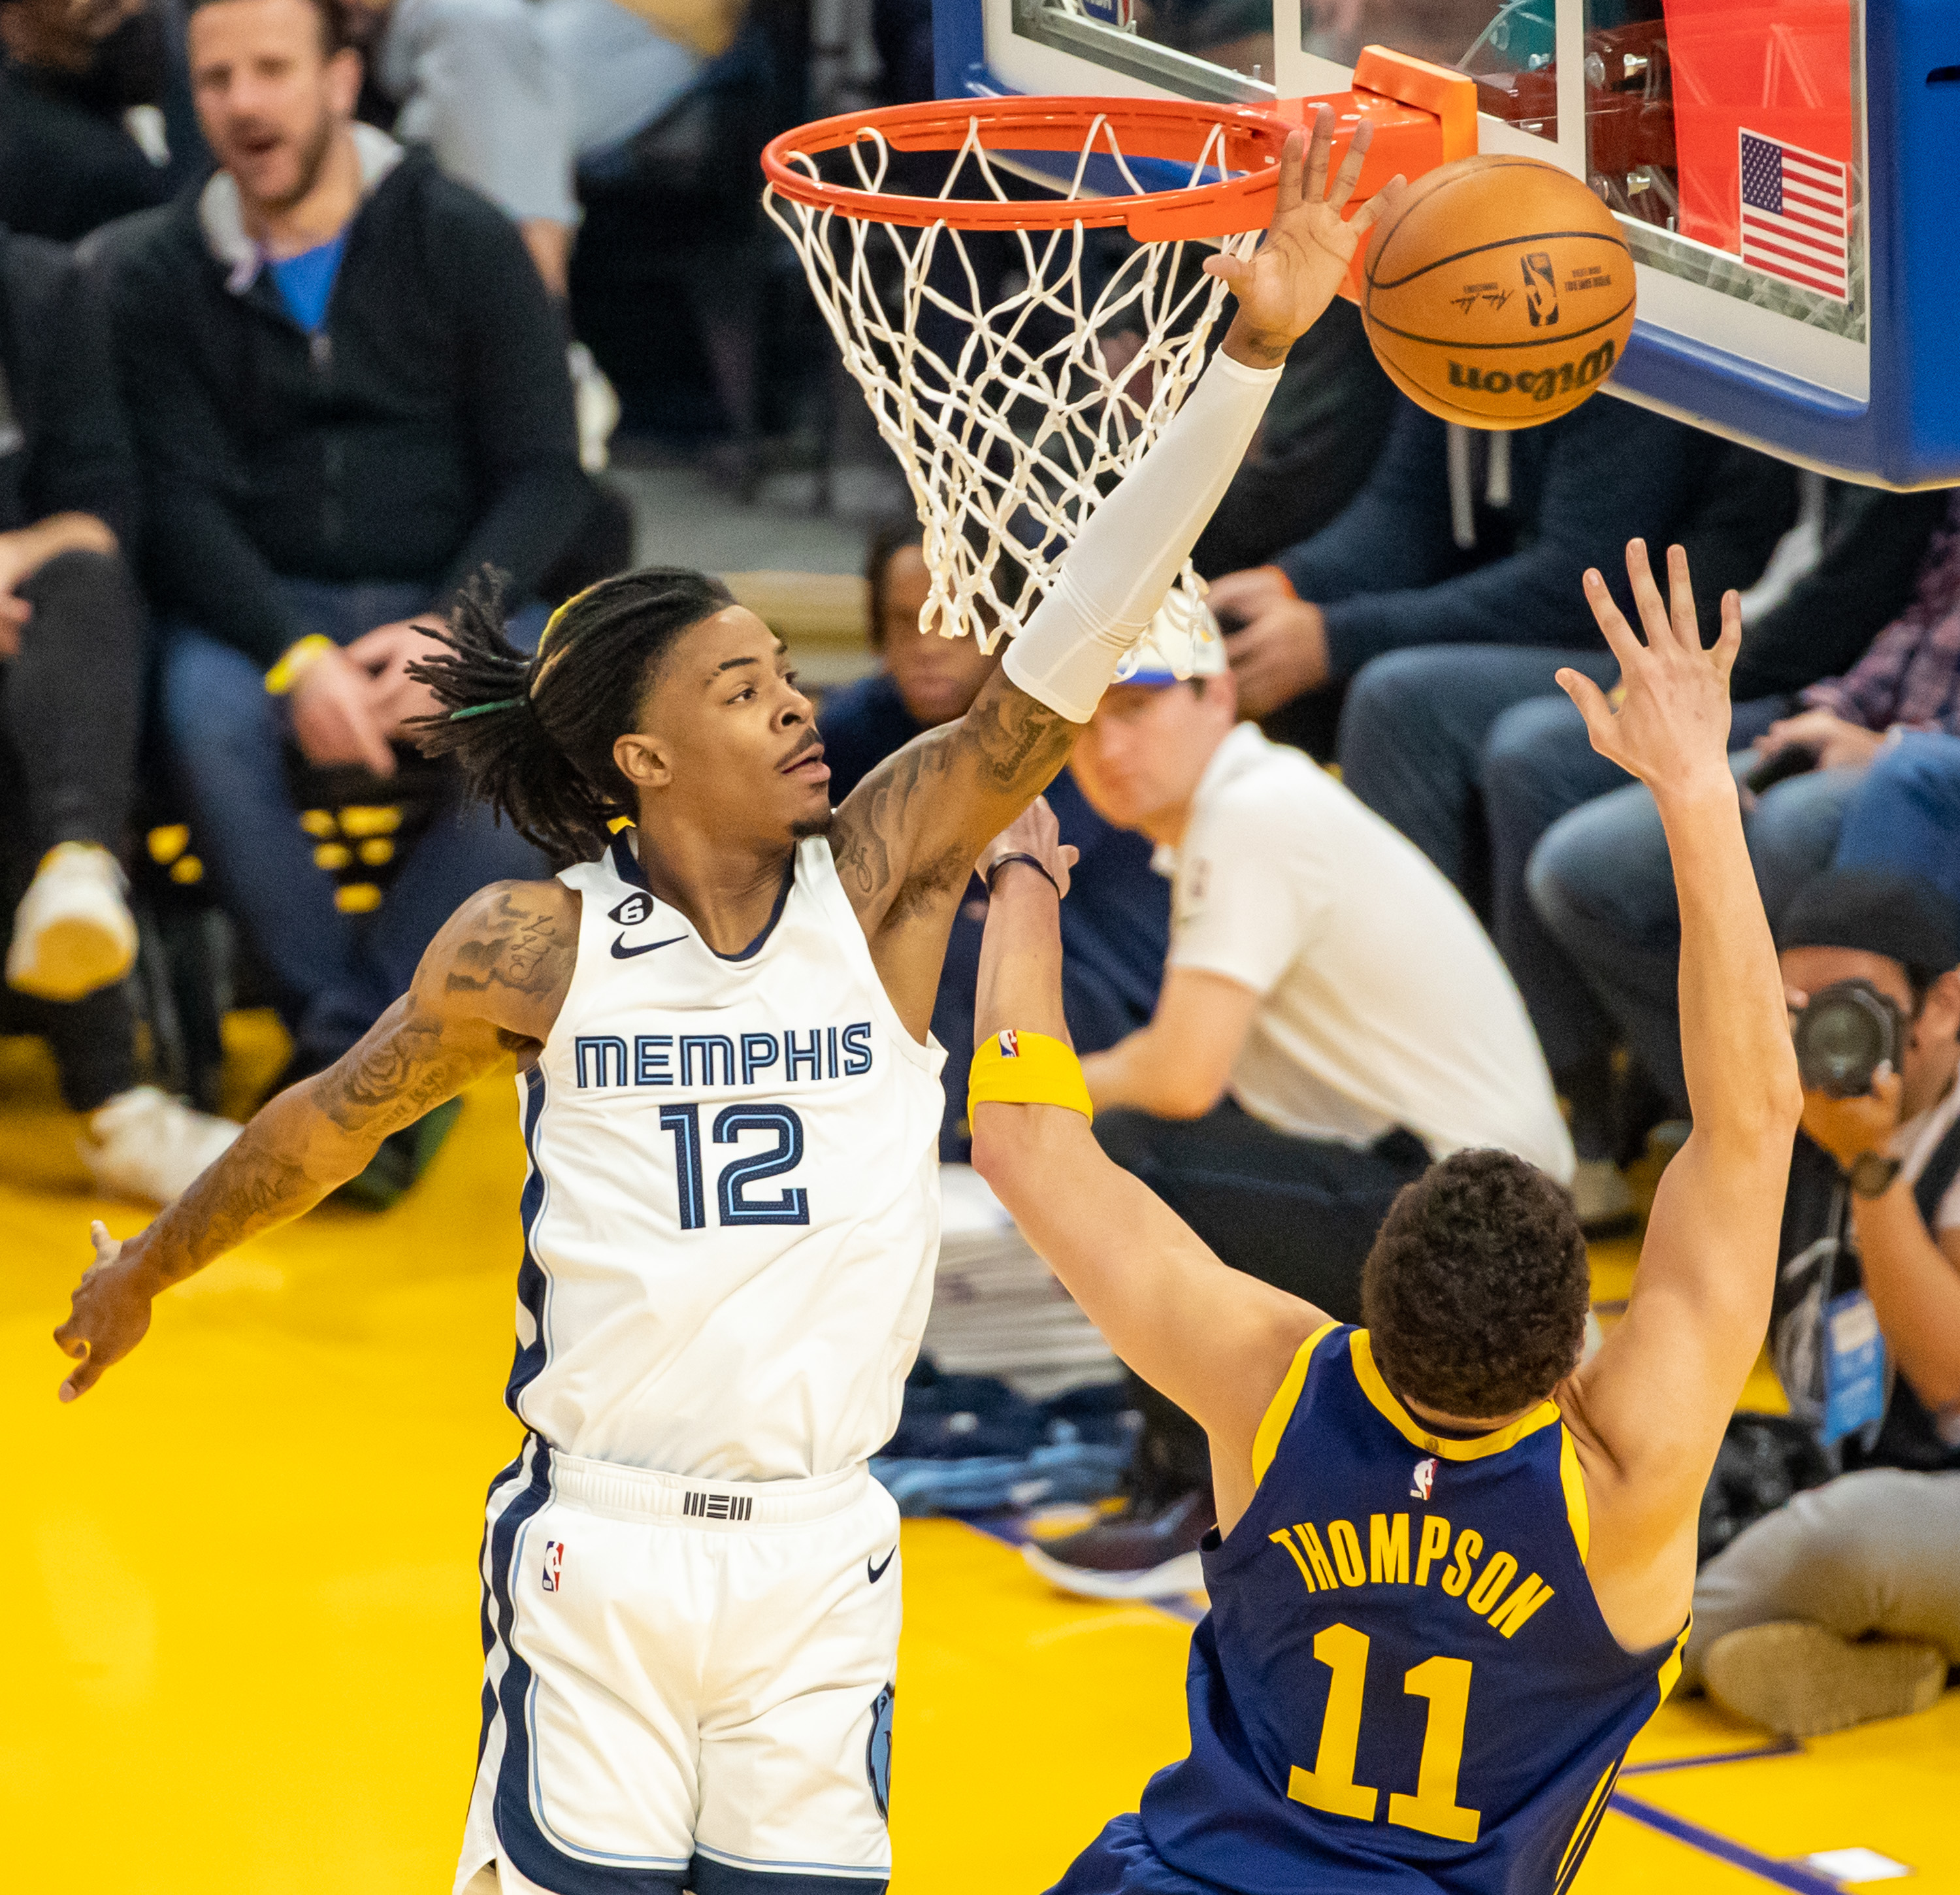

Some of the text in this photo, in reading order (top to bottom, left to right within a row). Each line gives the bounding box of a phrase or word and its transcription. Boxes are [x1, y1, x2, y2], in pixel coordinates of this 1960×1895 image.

[1448, 339, 1616, 403] Wilson
[620, 898, 644, 923] 6
[575, 1022, 872, 1088] MEMPHIS
[659, 1103, 809, 1229] 12
[1269, 1513, 1555, 1639] THOMPSON
[1287, 1622, 1480, 1843] 11
